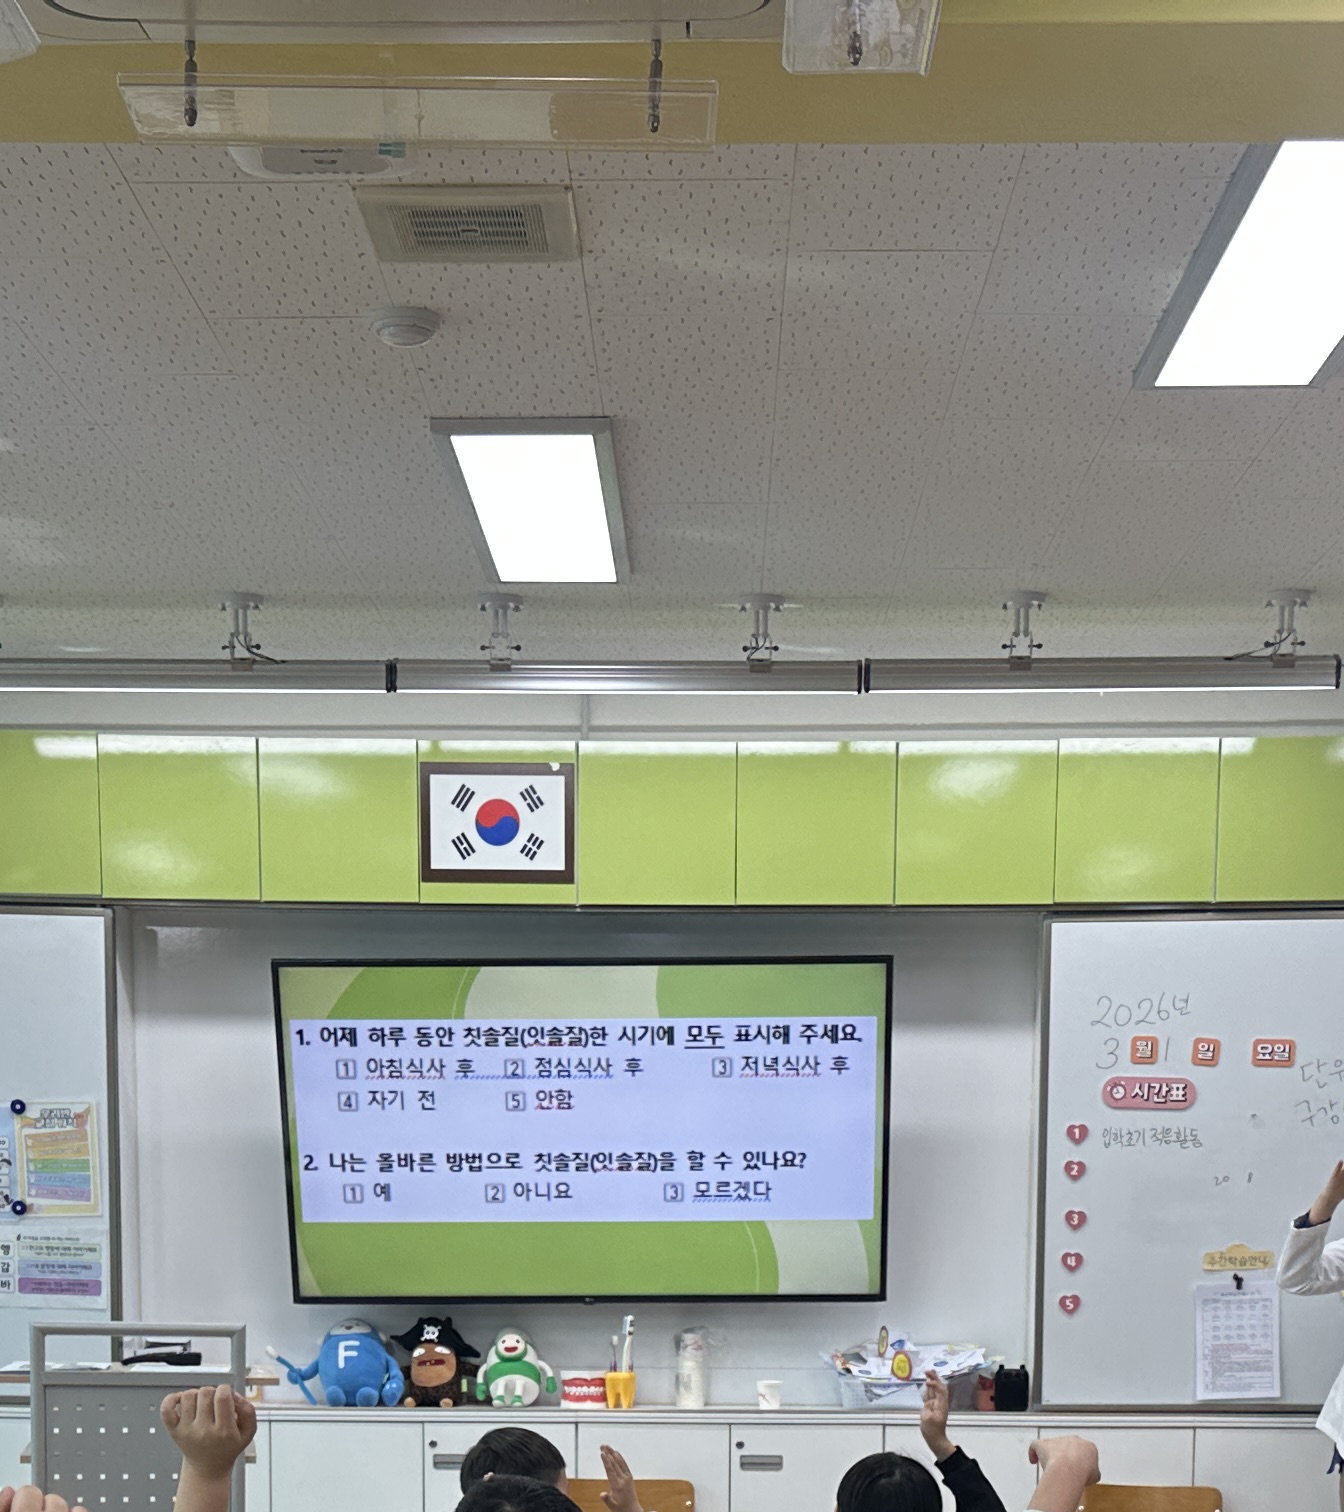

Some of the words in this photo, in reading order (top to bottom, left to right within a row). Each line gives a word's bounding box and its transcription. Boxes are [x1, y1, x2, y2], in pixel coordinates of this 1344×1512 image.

[1090, 992, 1191, 1028] 2026년
[295, 1028, 311, 1046] 1.
[320, 1027, 357, 1047] 어제
[368, 1027, 406, 1047] 하루
[414, 1026, 454, 1047] 동안
[618, 1026, 674, 1046] 시기에
[685, 1025, 725, 1044] 모두
[733, 1024, 790, 1044] 표시해
[799, 1023, 863, 1044] 주세요.
[1096, 1037, 1119, 1069] 3
[1135, 1040, 1152, 1058] 월
[1197, 1042, 1215, 1060] 일
[1256, 1043, 1290, 1061] 요일
[366, 1058, 446, 1077] 아침식사
[456, 1058, 475, 1077] 후
[534, 1057, 613, 1077] 점심식사
[624, 1057, 644, 1077] 후
[740, 1056, 821, 1076] 저녁식사
[829, 1056, 850, 1075] 후
[367, 1091, 405, 1111] 자기
[418, 1090, 436, 1111] 전
[535, 1089, 573, 1110] 안함
[1131, 1082, 1188, 1103] 시간표
[1074, 1128, 1080, 1139] 1
[1102, 1126, 1146, 1148] 입학초기
[329, 1153, 367, 1172] 나는
[376, 1152, 436, 1172] 올바른
[446, 1152, 523, 1172] 방법으로
[687, 1150, 705, 1171] 할
[713, 1152, 733, 1171] 수
[743, 1150, 807, 1171] 있나요?
[1070, 1164, 1079, 1175] 2
[373, 1183, 391, 1201] 예
[513, 1182, 573, 1201] 아니요
[693, 1181, 772, 1200] 모르겠다
[1070, 1214, 1079, 1225] 3
[1067, 1256, 1076, 1267] 4
[0, 1280, 11, 1290] 바
[1065, 1299, 1074, 1310] 5
[337, 1340, 361, 1369] F
